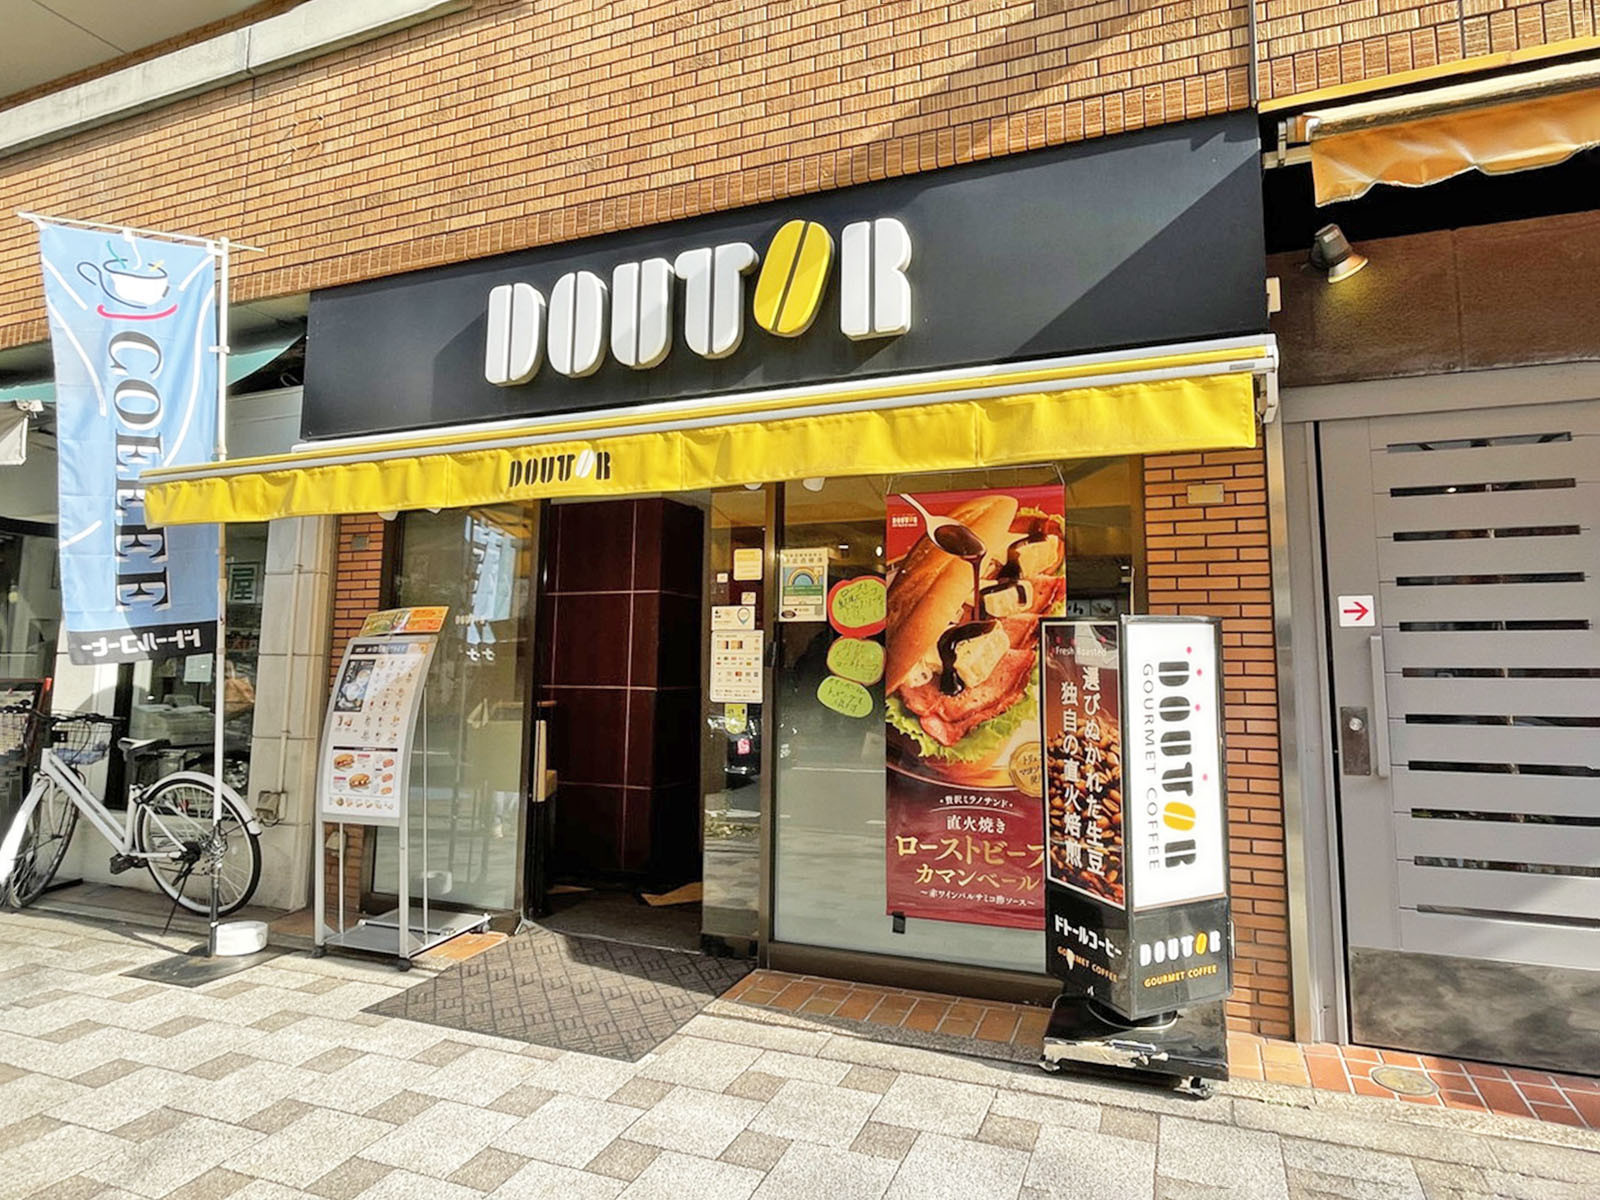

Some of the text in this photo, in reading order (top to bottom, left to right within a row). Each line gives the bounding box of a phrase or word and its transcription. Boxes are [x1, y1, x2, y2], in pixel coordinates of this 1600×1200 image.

[485, 217, 913, 387] DOUTOR
[508, 449, 611, 488] DOUTOR
[1060, 681, 1083, 870] 独自の直火焙煎
[1081, 666, 1106, 878] 選びぬかれた生豆
[1142, 663, 1160, 870] GOURMET COFFEE
[1158, 660, 1197, 869] DOUTOR
[947, 814, 1006, 835] 直火焼き
[895, 835, 1044, 869] ローストビーフ
[914, 863, 1041, 892] カマンベール
[1054, 914, 1122, 958] ドトールコーヒー
[1139, 930, 1222, 967] DOUTOR
[1056, 945, 1118, 984] GOMET COFFEE
[1143, 964, 1218, 988] GOURMET COFFEE
